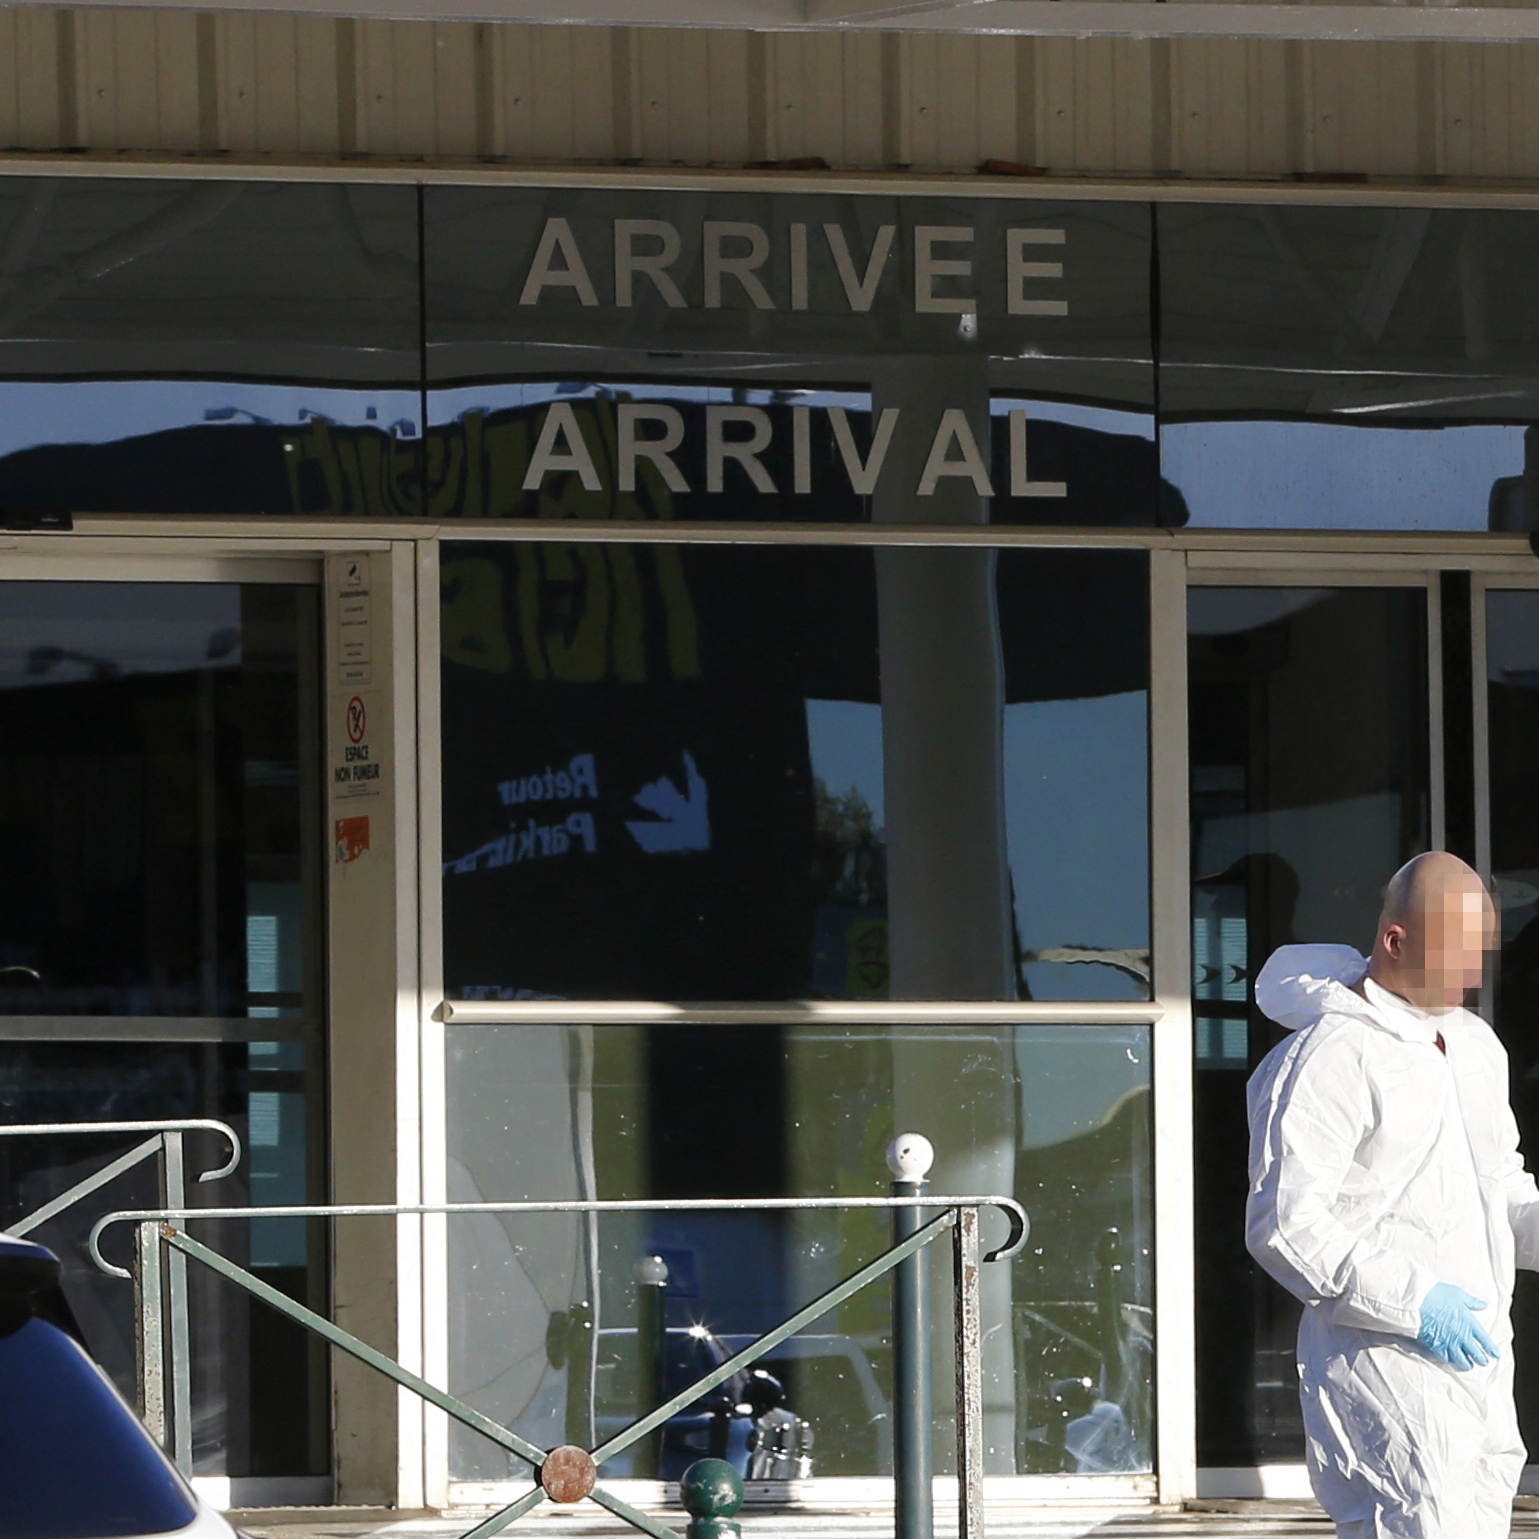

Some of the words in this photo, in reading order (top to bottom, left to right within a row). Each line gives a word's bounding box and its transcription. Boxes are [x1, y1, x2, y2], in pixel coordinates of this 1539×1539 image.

[519, 217, 1068, 316] ARRIVEE
[522, 402, 1067, 497] ARRIVAL
[335, 767, 351, 783] NON
[345, 745, 369, 762] ESPACE
